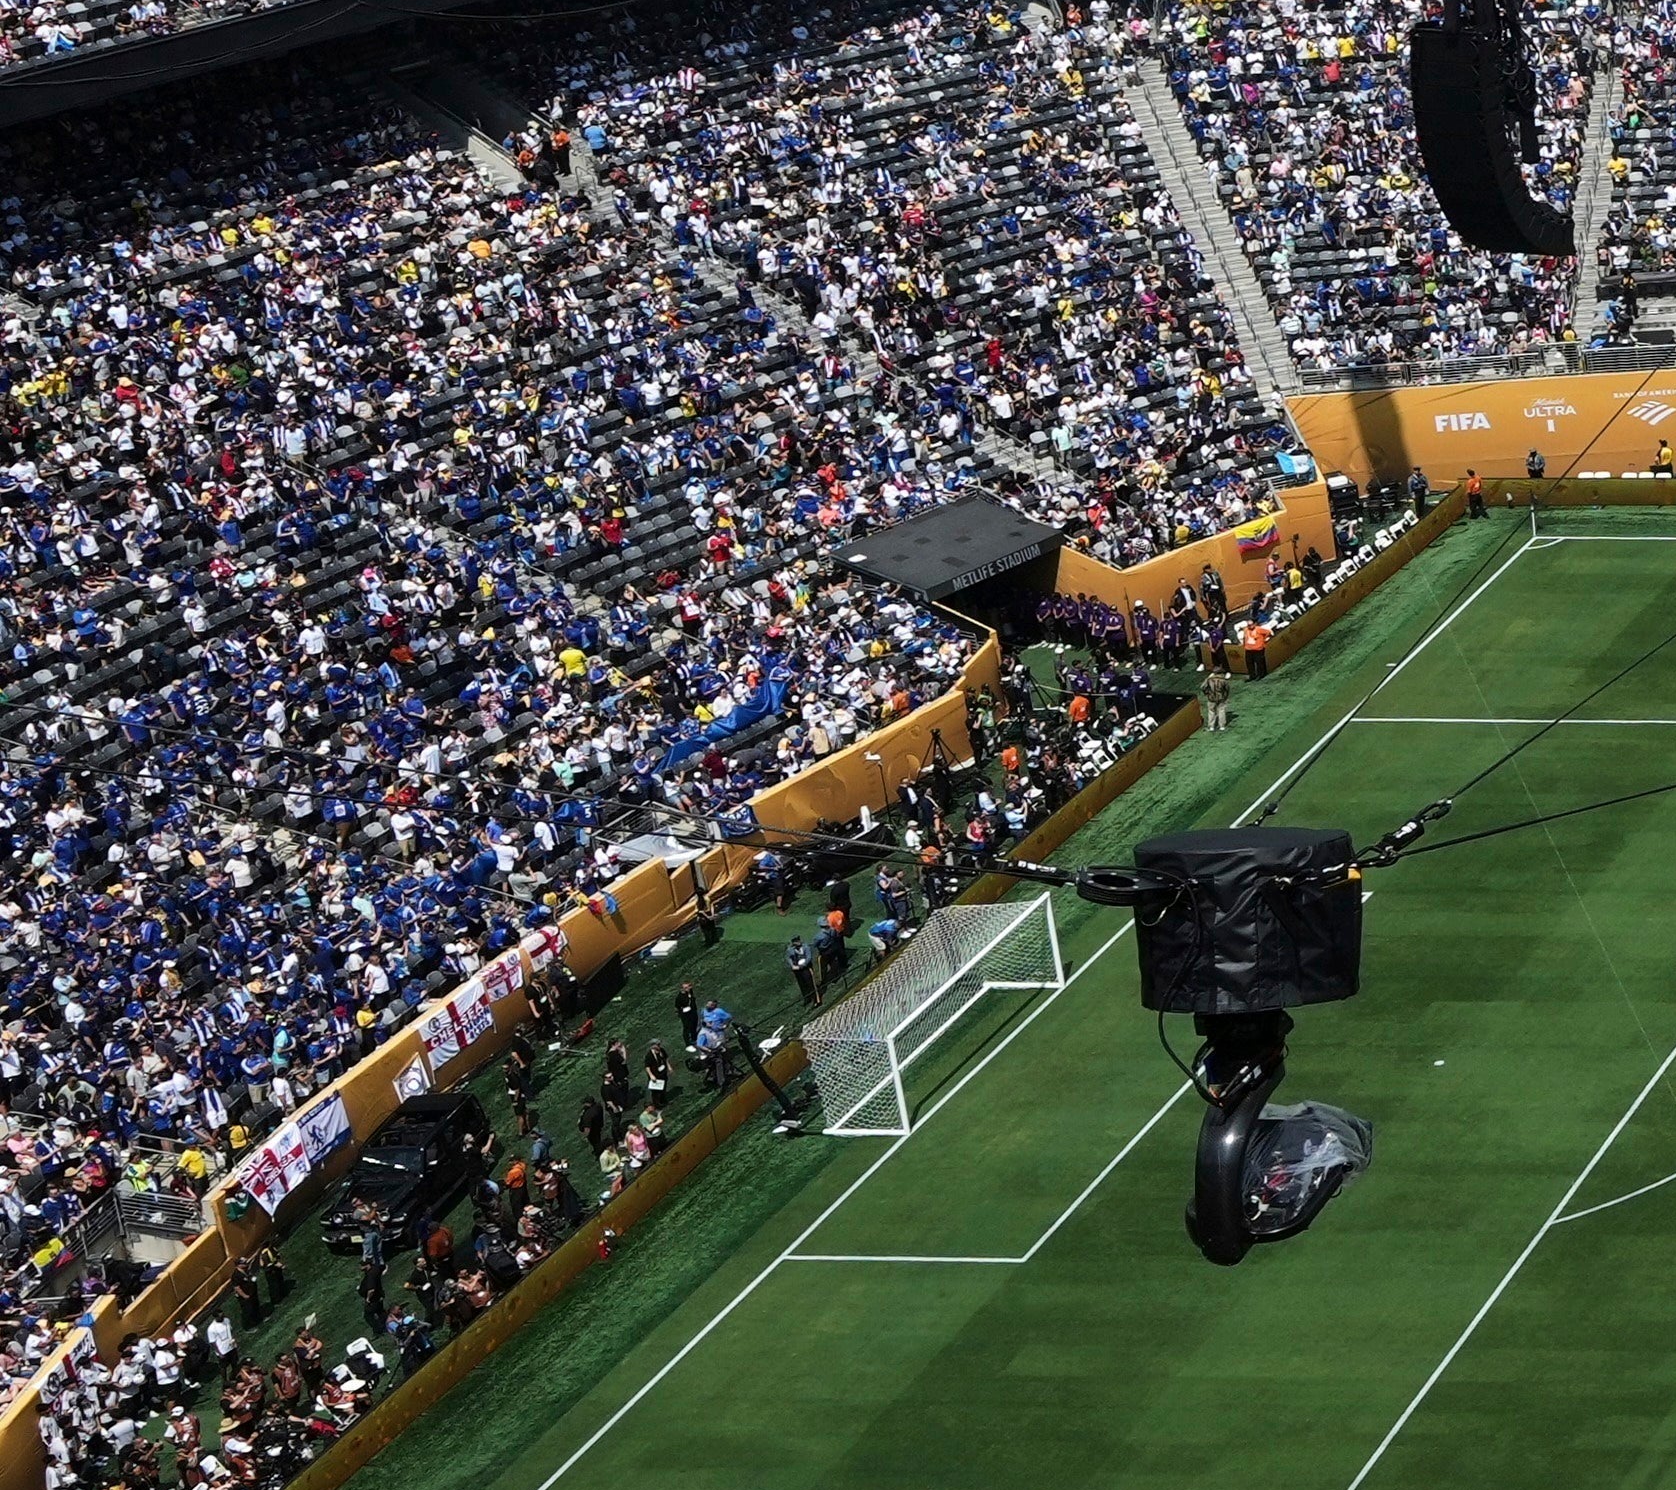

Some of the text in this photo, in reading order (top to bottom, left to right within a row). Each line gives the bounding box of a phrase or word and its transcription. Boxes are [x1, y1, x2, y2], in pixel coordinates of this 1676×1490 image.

[1434, 413, 1492, 432] FIFA
[1523, 404, 1578, 418] ULTRA
[952, 543, 1042, 592] METLIFE STADIUM
[431, 1000, 485, 1050] CHELSEA
[264, 1152, 296, 1187] CHELSEA
